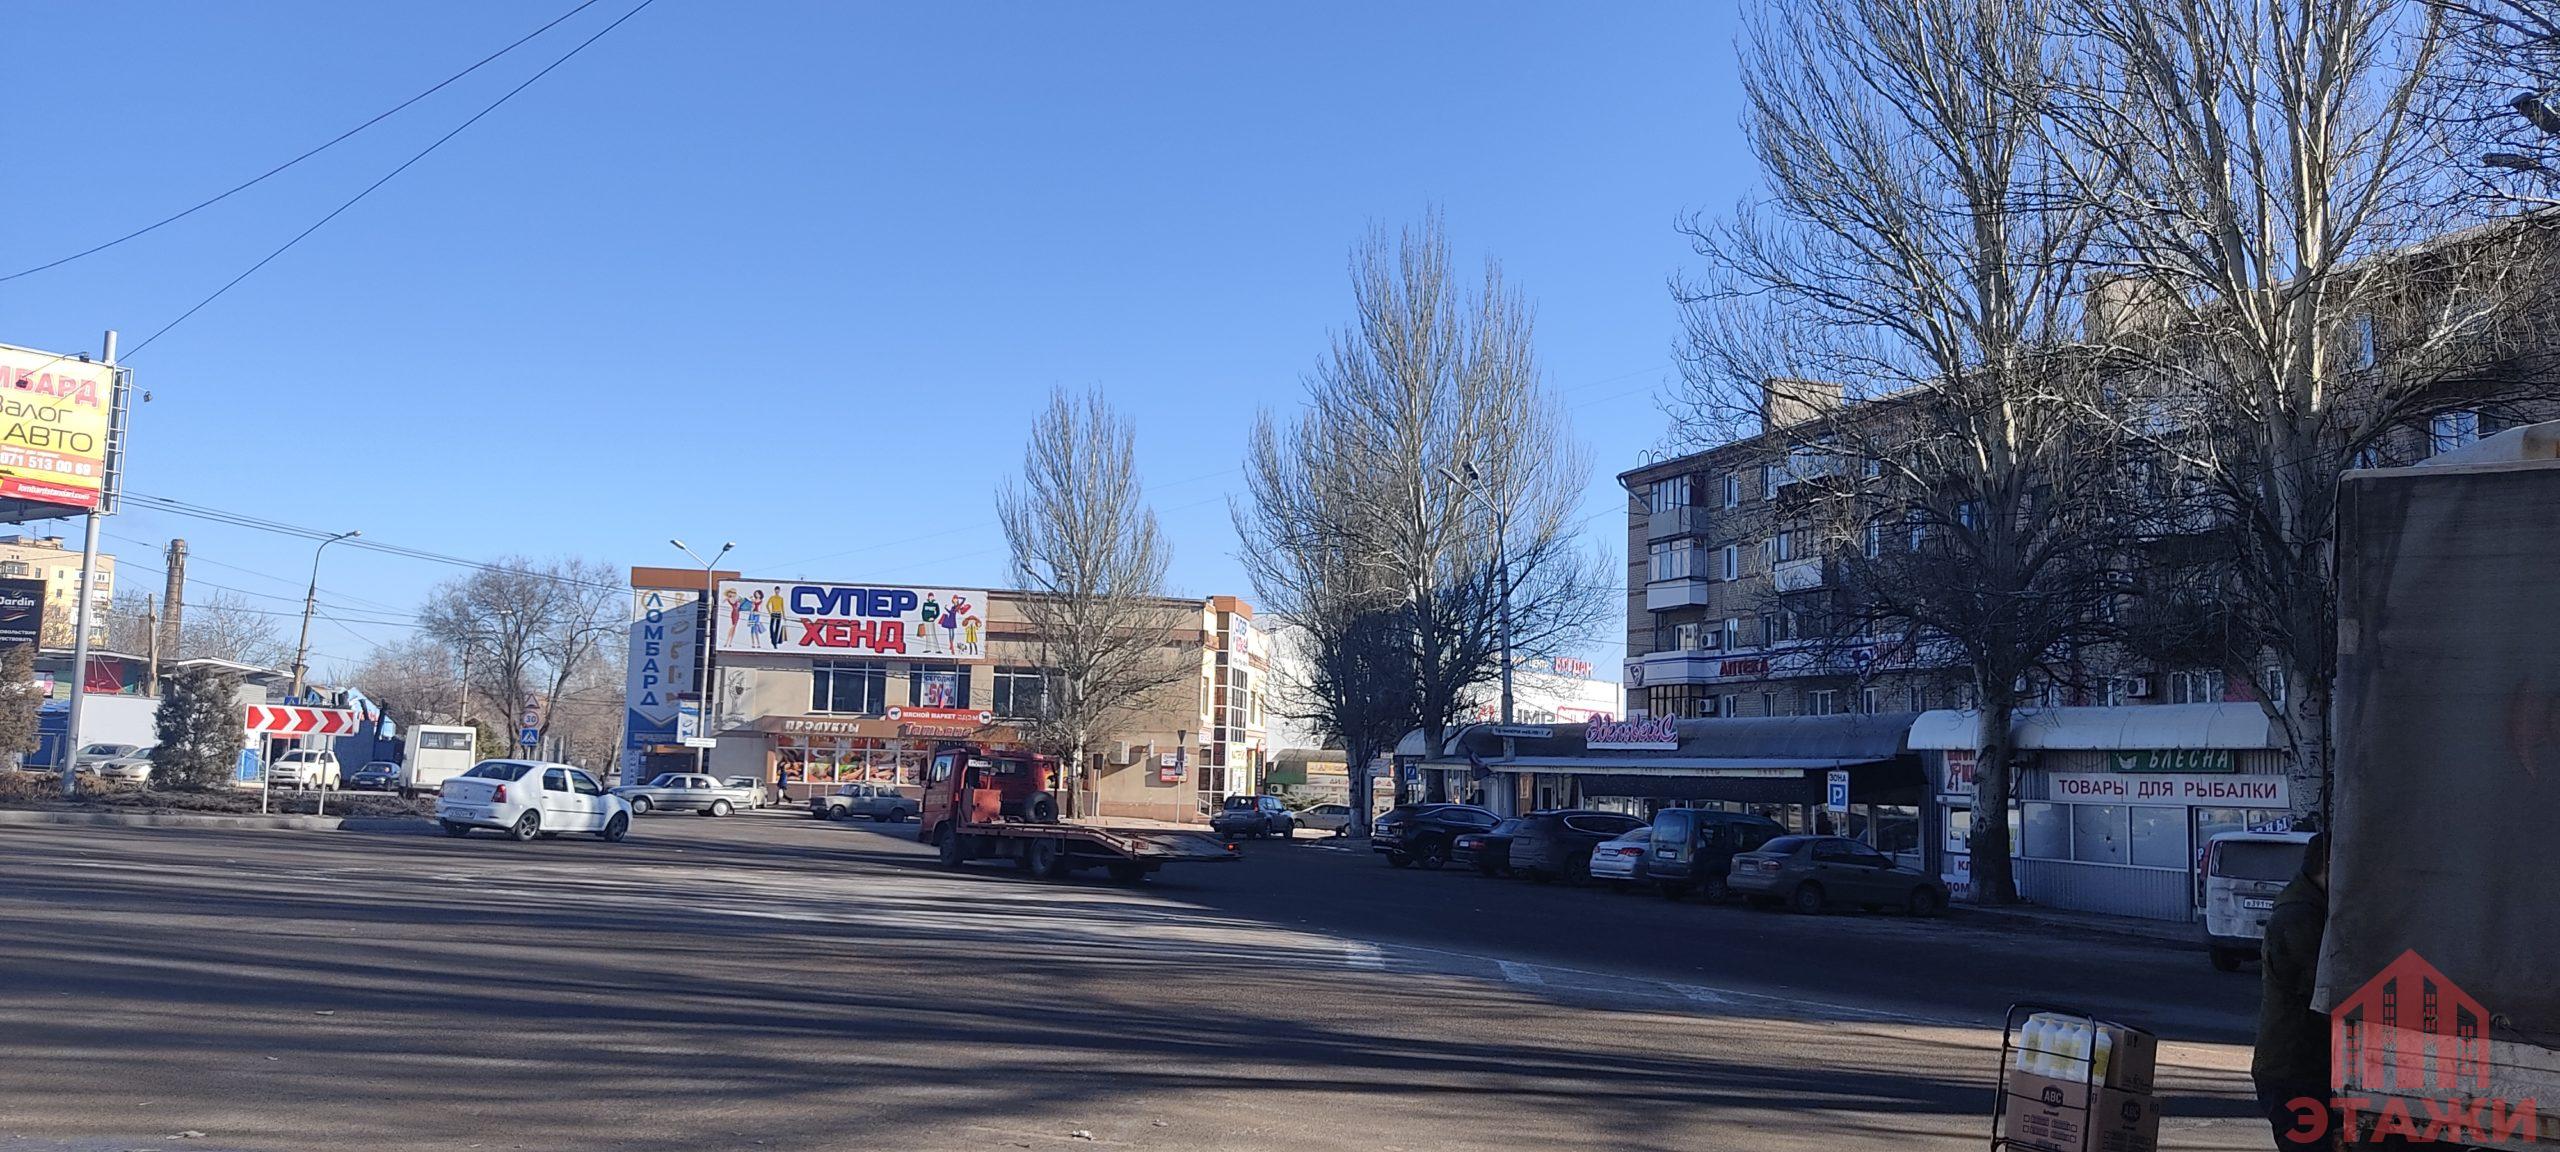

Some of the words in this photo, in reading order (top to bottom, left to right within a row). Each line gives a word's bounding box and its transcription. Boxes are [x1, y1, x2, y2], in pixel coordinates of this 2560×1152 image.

[4, 423, 93, 452] АВТО
[28, 455, 52, 471] 513
[0, 597, 35, 607] Jardin
[791, 586, 918, 617] СУПЕР
[798, 617, 906, 654] ХЕНД
[640, 592, 664, 706] ЛОМБАРД
[526, 715, 537, 723] 30
[2149, 752, 2230, 769] БЛЕСНА
[1828, 774, 1847, 783] ЗОНА
[2059, 779, 2129, 796] ТОВАРЫ
[2137, 781, 2174, 799] ДЛЯ
[2184, 782, 2277, 799] РЫБАЛКИ
[2044, 1090, 2062, 1103] ABC
